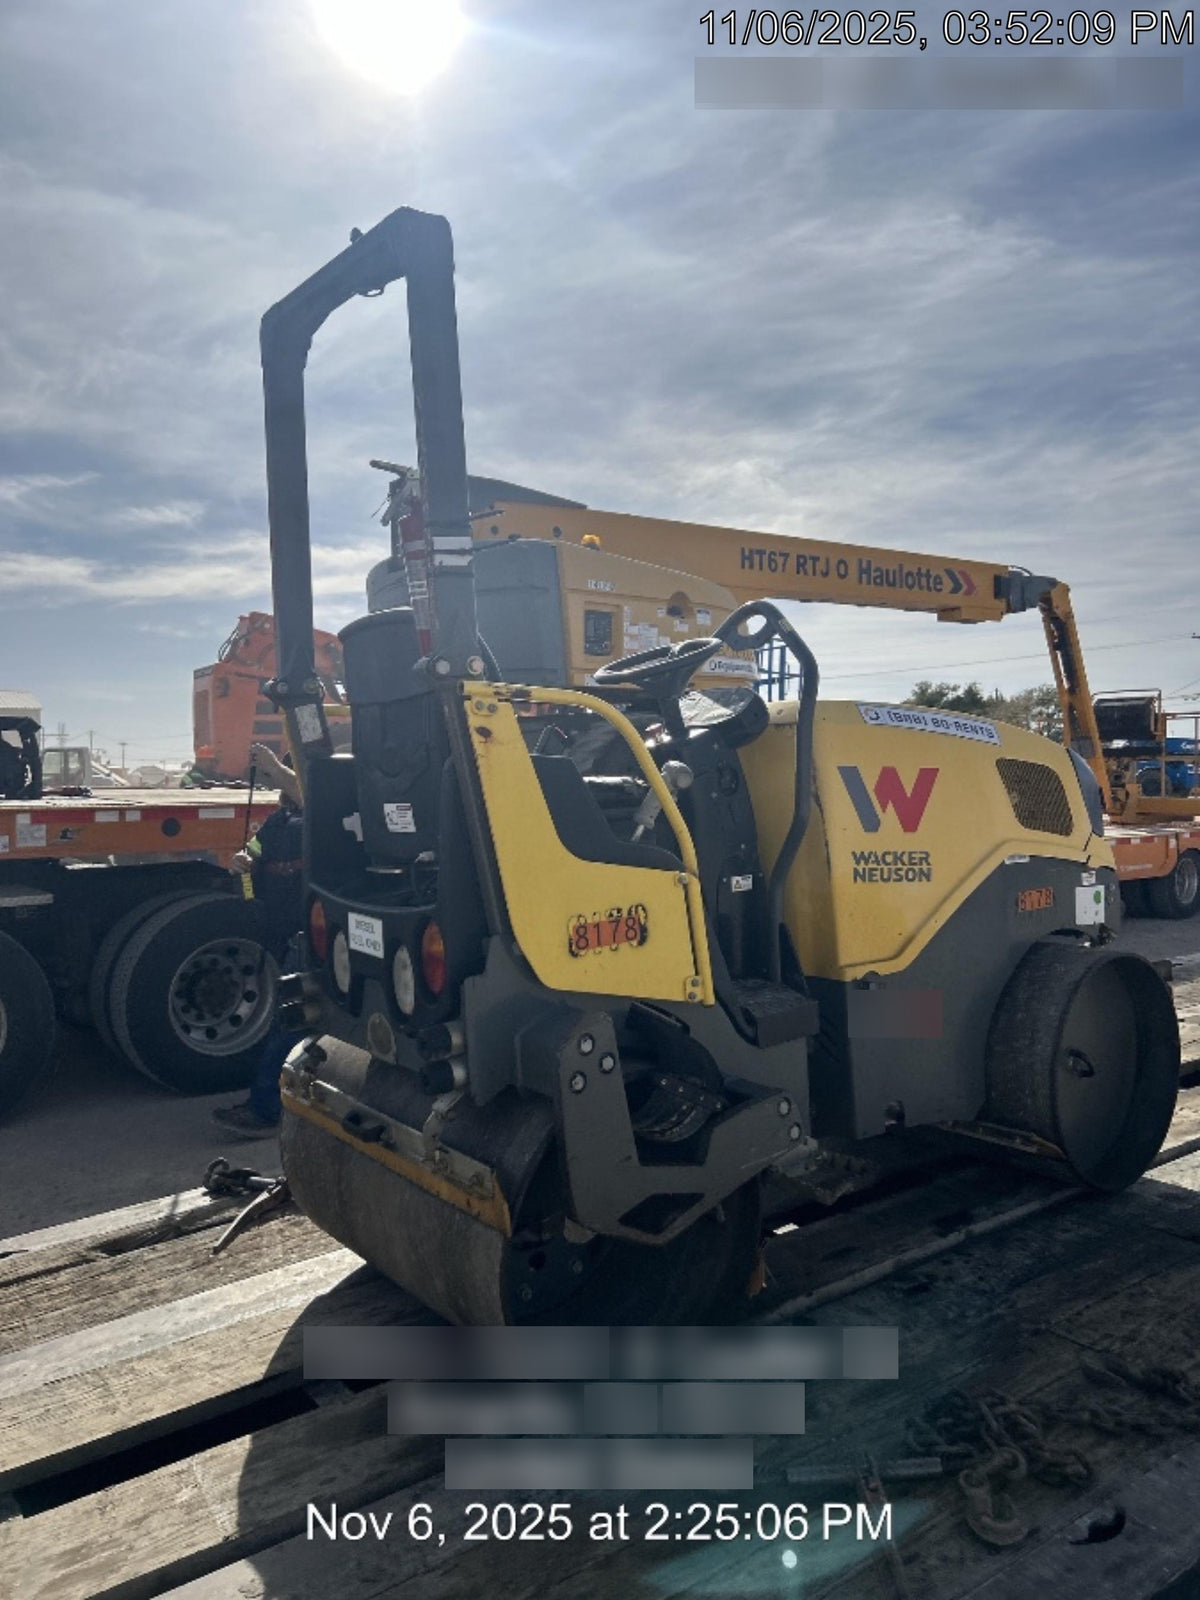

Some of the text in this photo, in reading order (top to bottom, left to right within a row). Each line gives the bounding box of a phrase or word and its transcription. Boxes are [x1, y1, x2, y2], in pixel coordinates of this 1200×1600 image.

[740, 546, 790, 573] HT67
[796, 553, 831, 578] RTJ
[857, 557, 944, 593] Haulotte
[852, 851, 931, 867] WACKER
[853, 867, 932, 883] NEUSON
[575, 916, 638, 951] 8178
